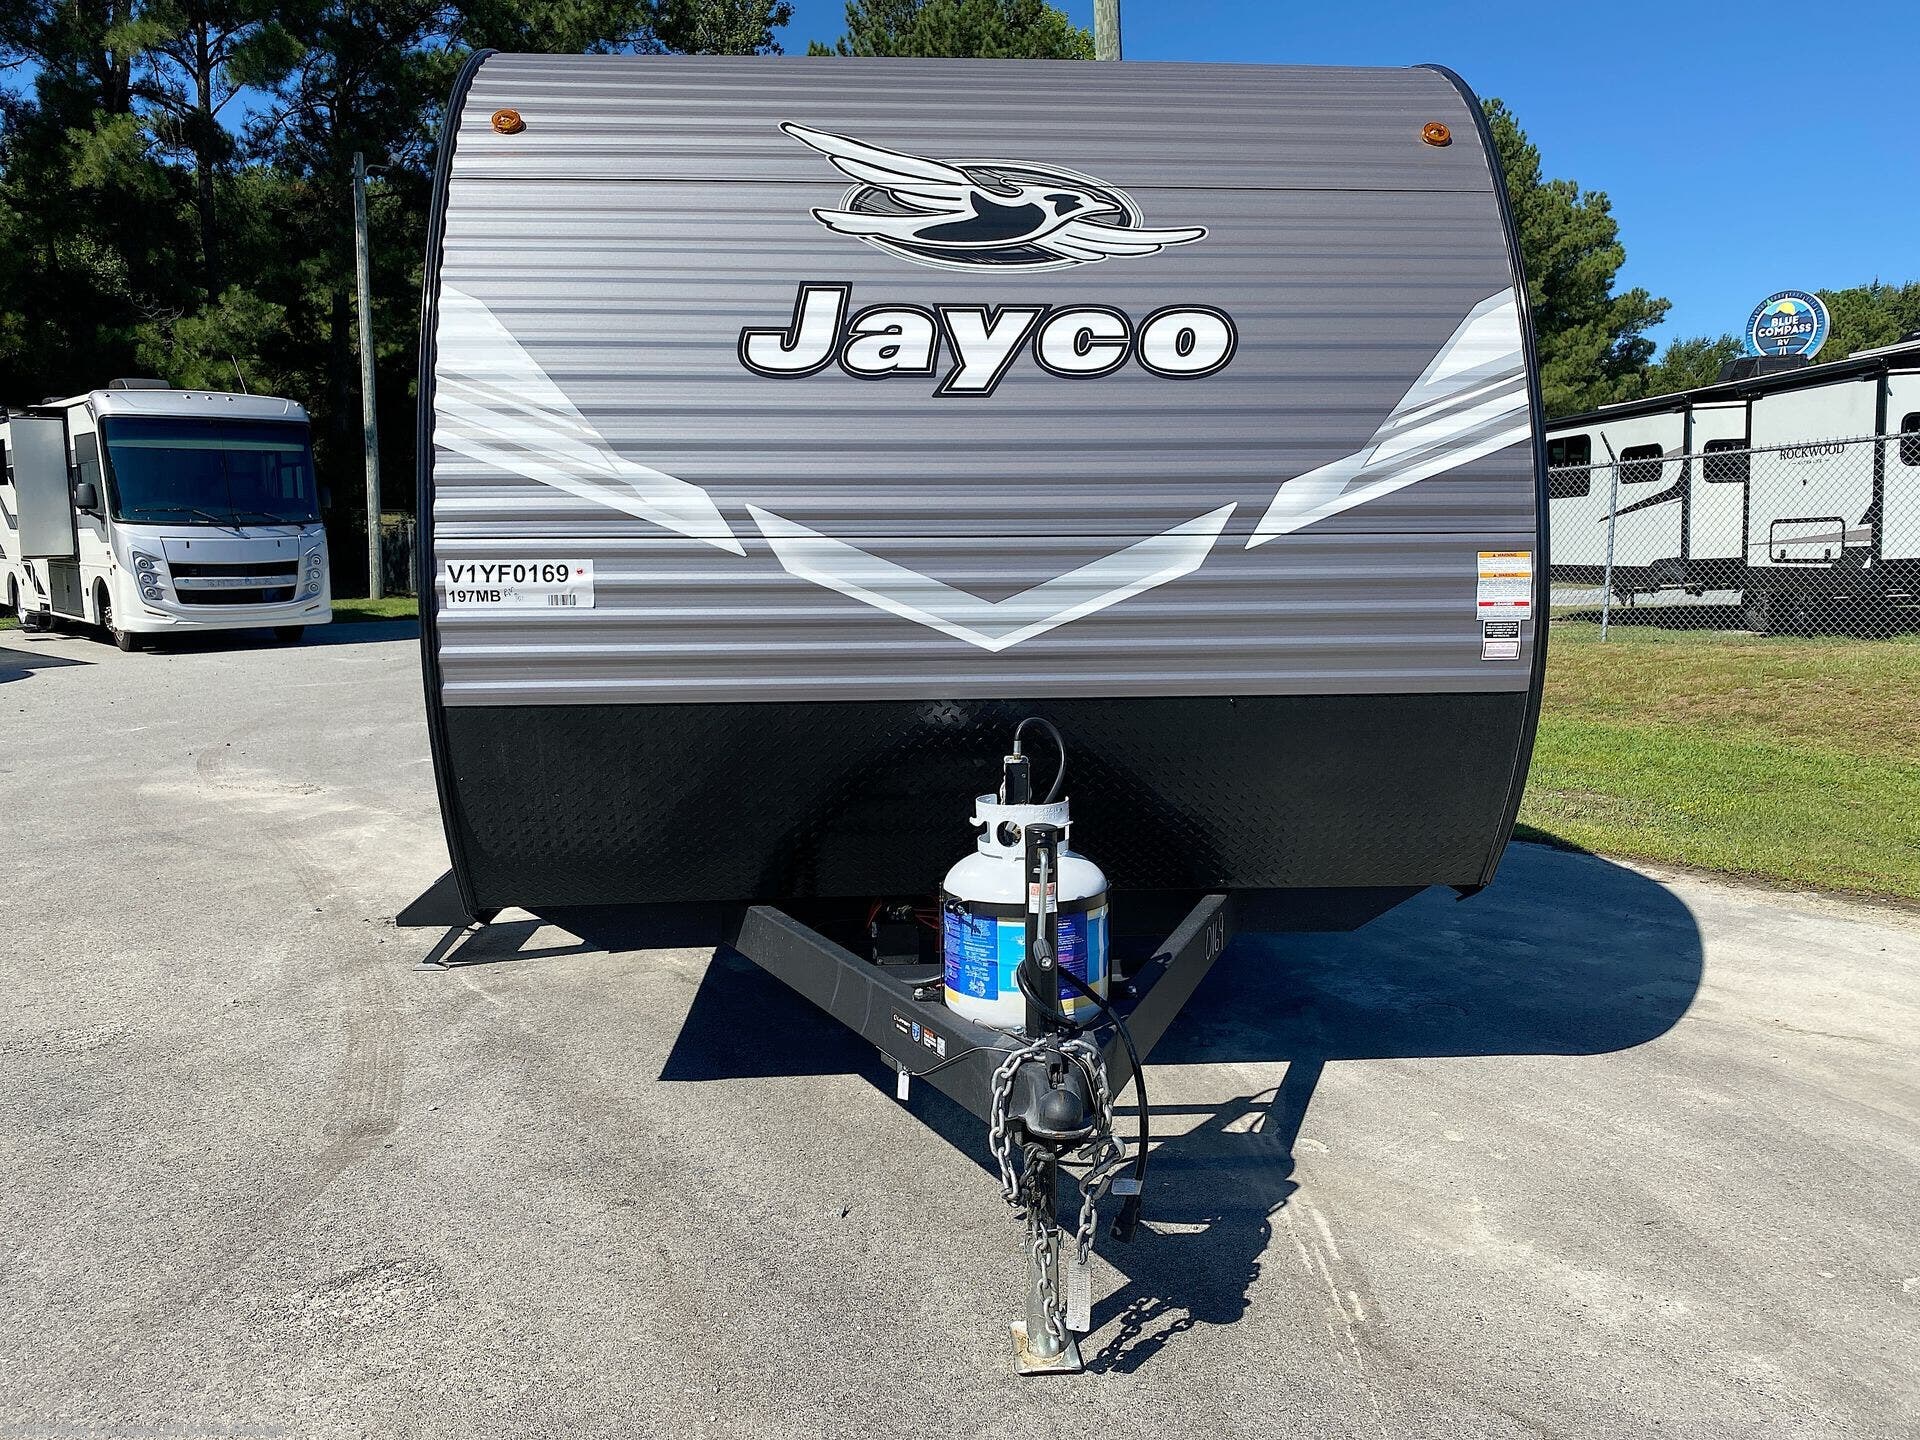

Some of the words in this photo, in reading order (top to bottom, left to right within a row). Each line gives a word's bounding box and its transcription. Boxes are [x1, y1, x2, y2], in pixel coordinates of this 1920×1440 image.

[1771, 315, 1799, 327] BLUE
[1758, 323, 1812, 337] COMPASS
[737, 281, 1238, 398] Jayco
[1779, 443, 1844, 460] ROCKWOOD
[447, 564, 569, 583] V1YF0169
[448, 590, 501, 603] 197MB
